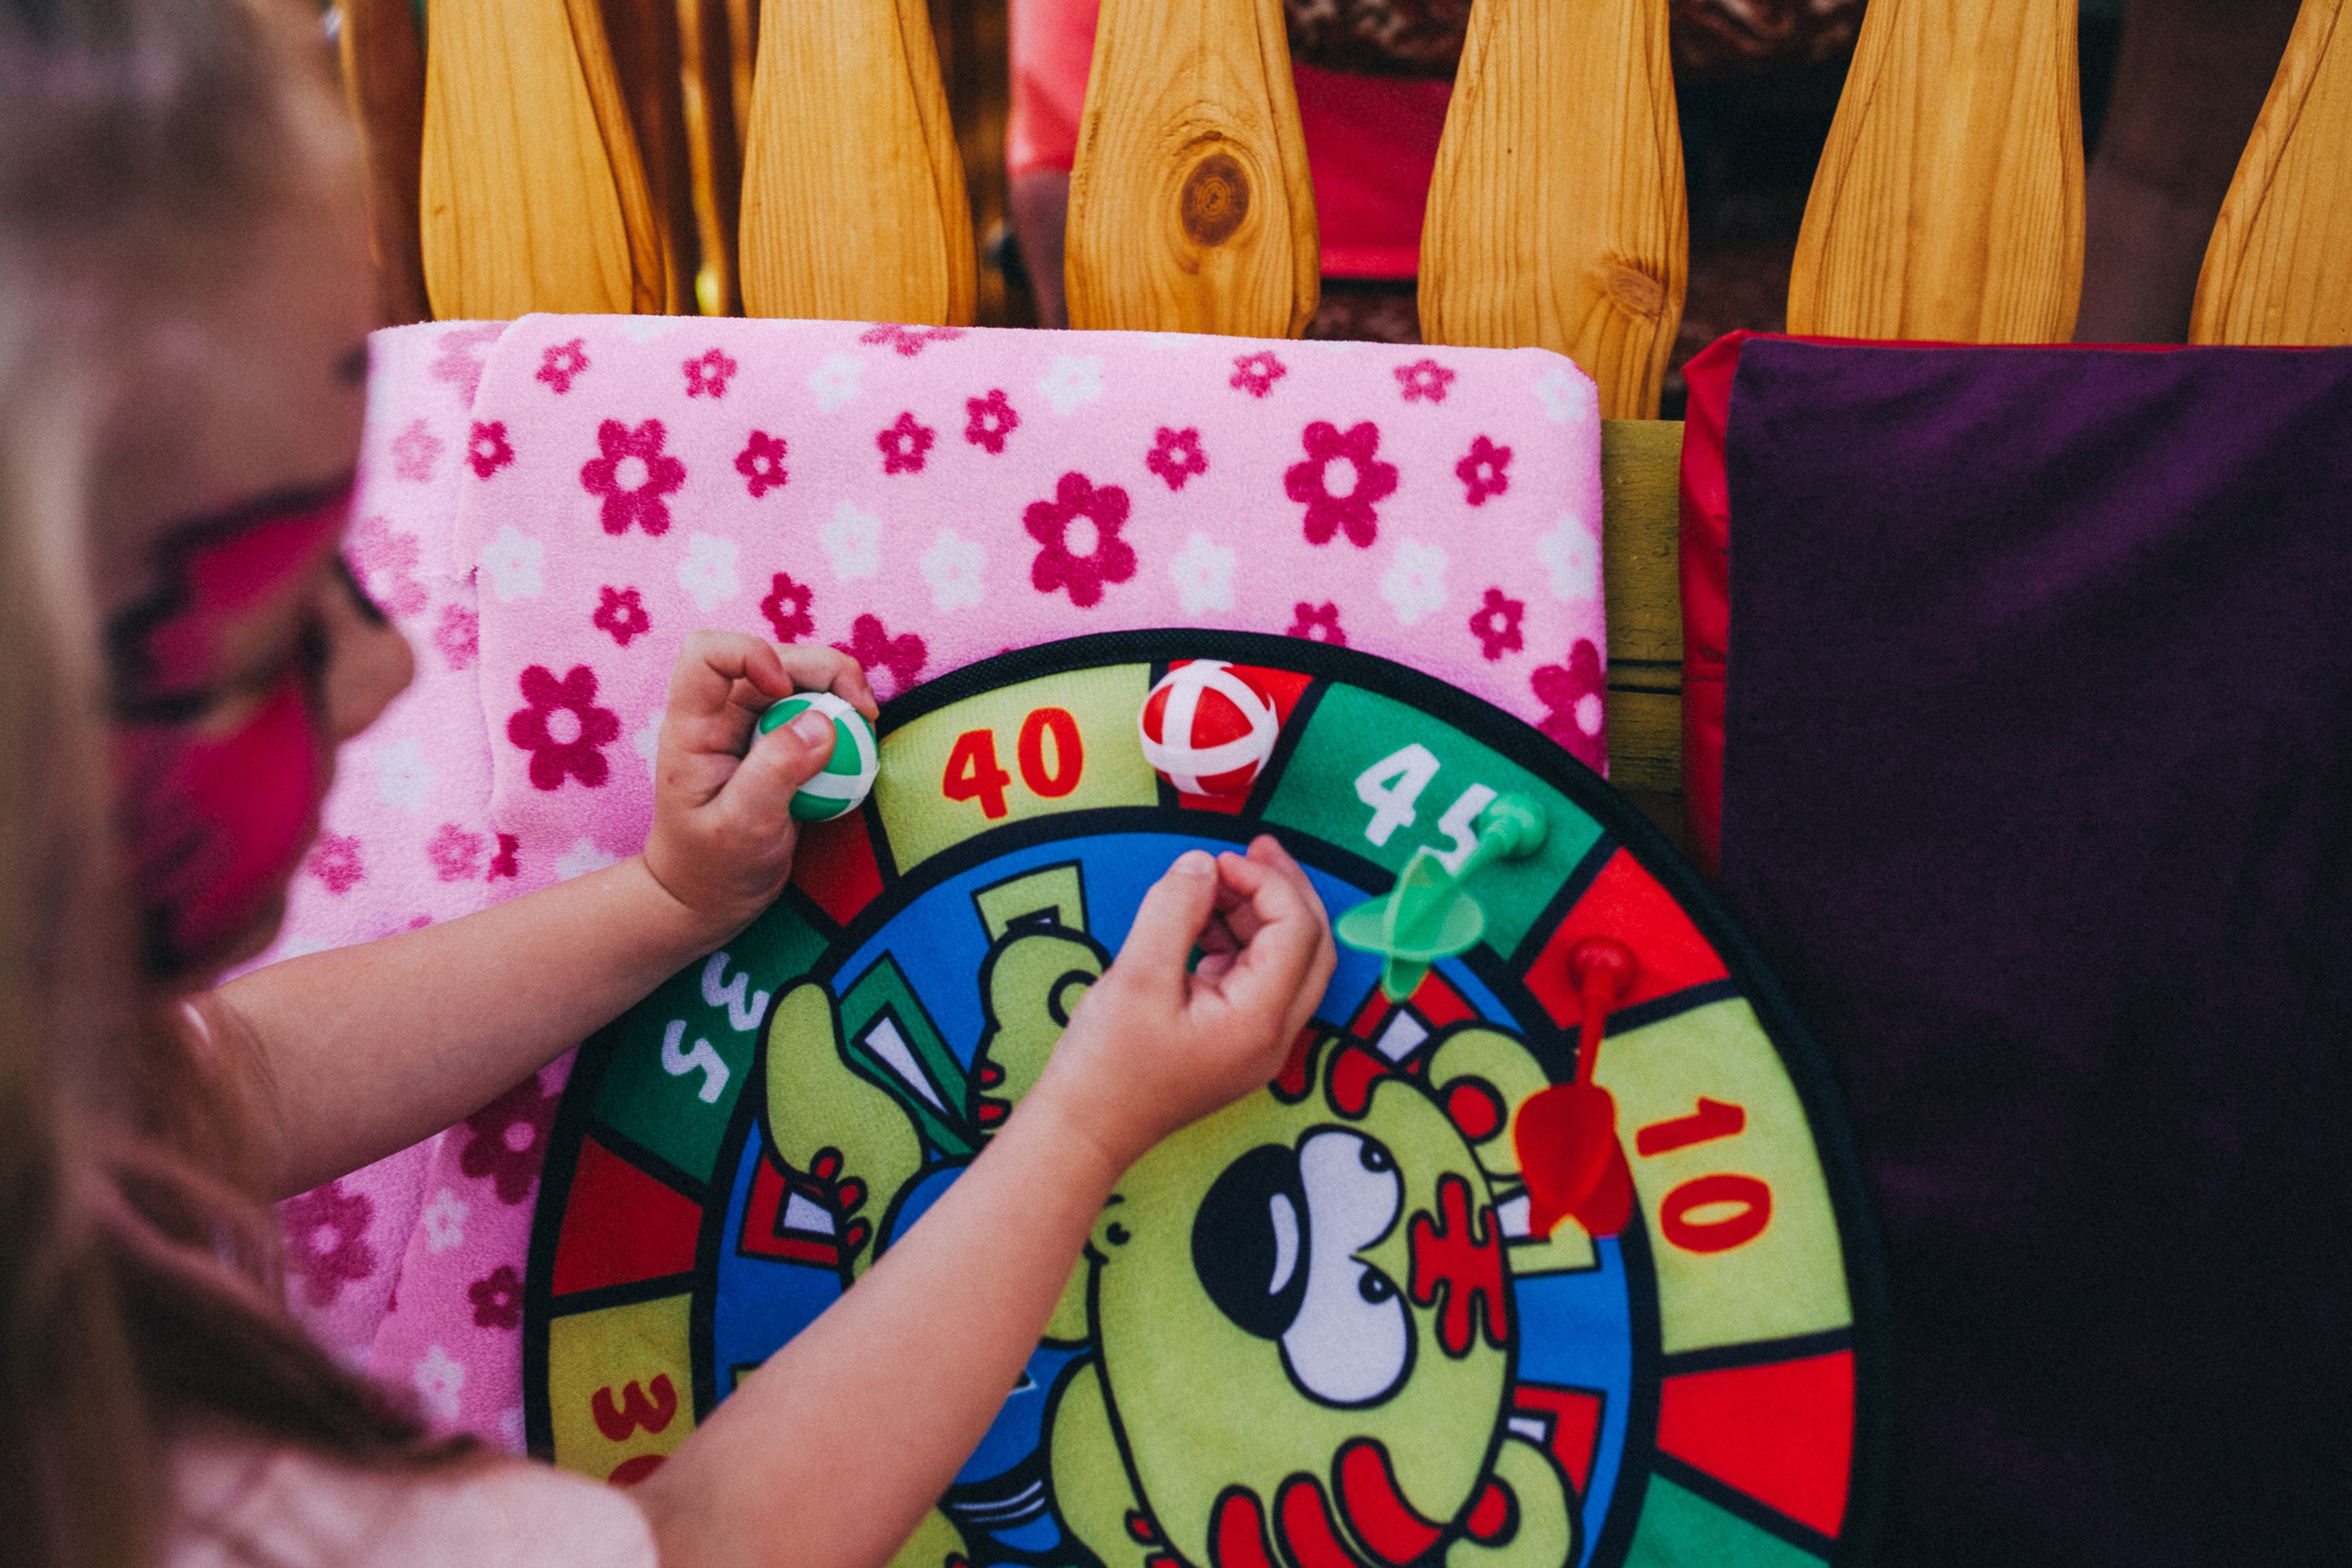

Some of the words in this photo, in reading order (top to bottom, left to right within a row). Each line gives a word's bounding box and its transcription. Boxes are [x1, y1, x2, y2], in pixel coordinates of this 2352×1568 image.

[942, 706, 1085, 820] 40
[1354, 742, 1498, 878] 45
[661, 951, 771, 1104] 35
[1634, 1096, 1773, 1256] 10
